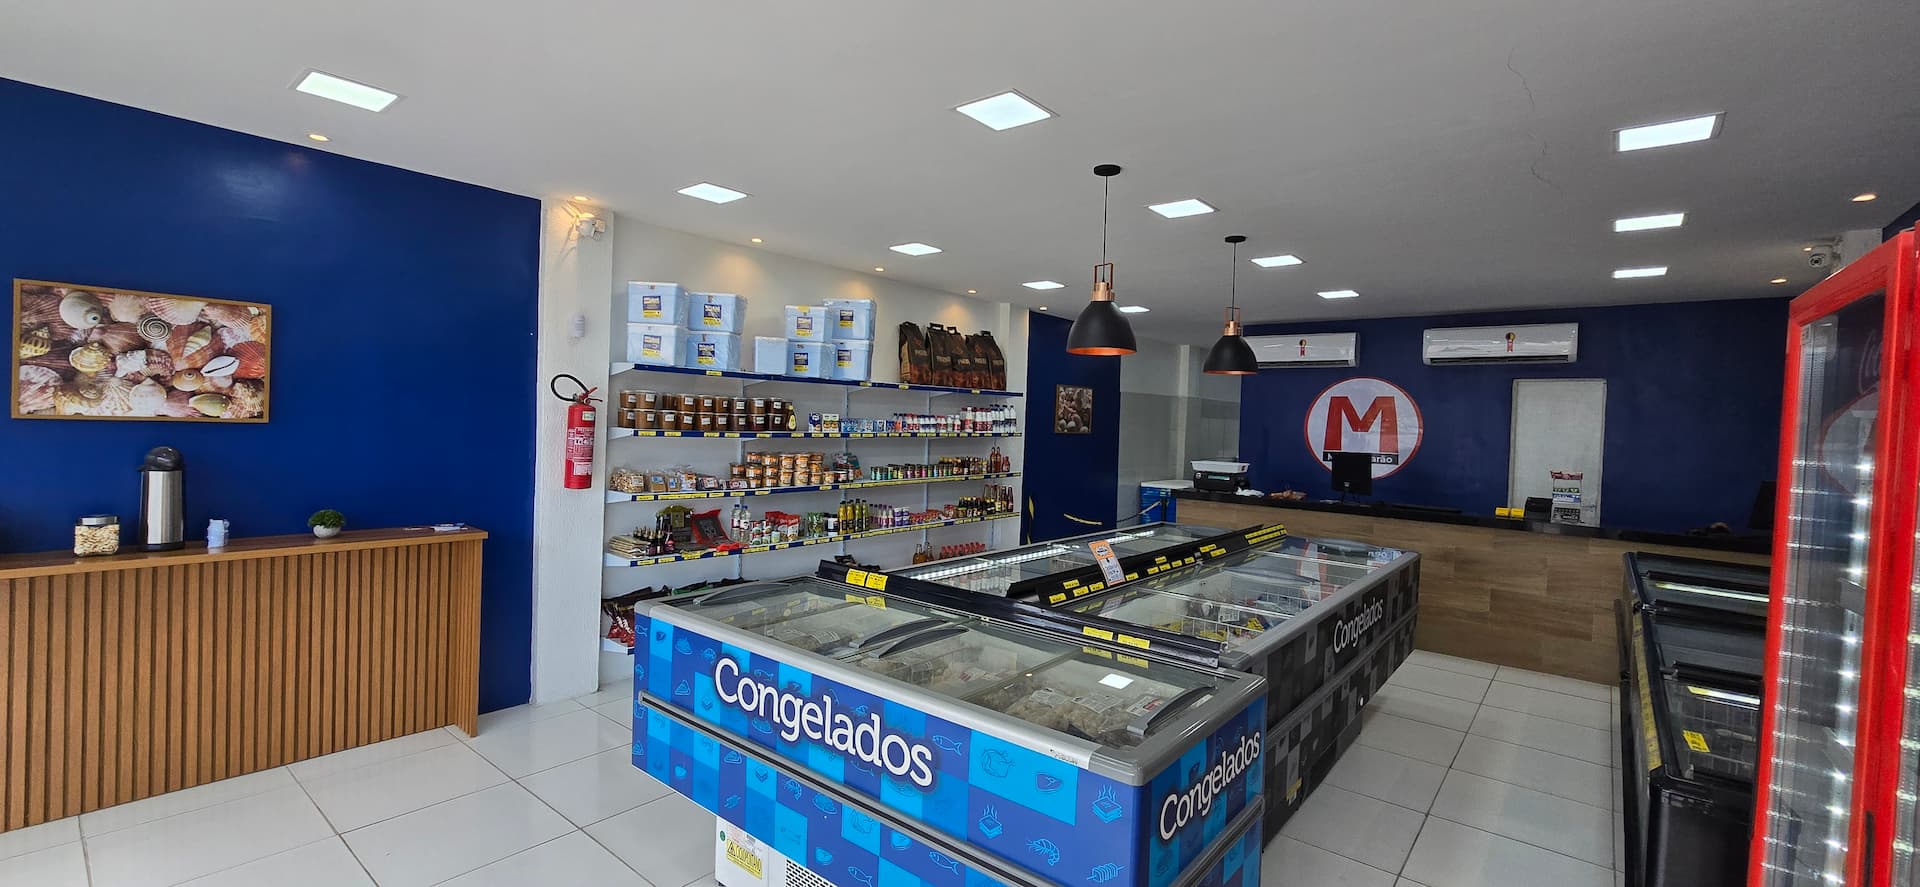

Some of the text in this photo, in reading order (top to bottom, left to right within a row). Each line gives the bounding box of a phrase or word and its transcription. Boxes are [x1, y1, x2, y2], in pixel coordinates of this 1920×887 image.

[1324, 396, 1399, 454] M
[1370, 456, 1393, 464] arão
[1333, 597, 1384, 654] Congelados
[715, 658, 933, 787] Congelados
[1160, 731, 1260, 840] Congelados
